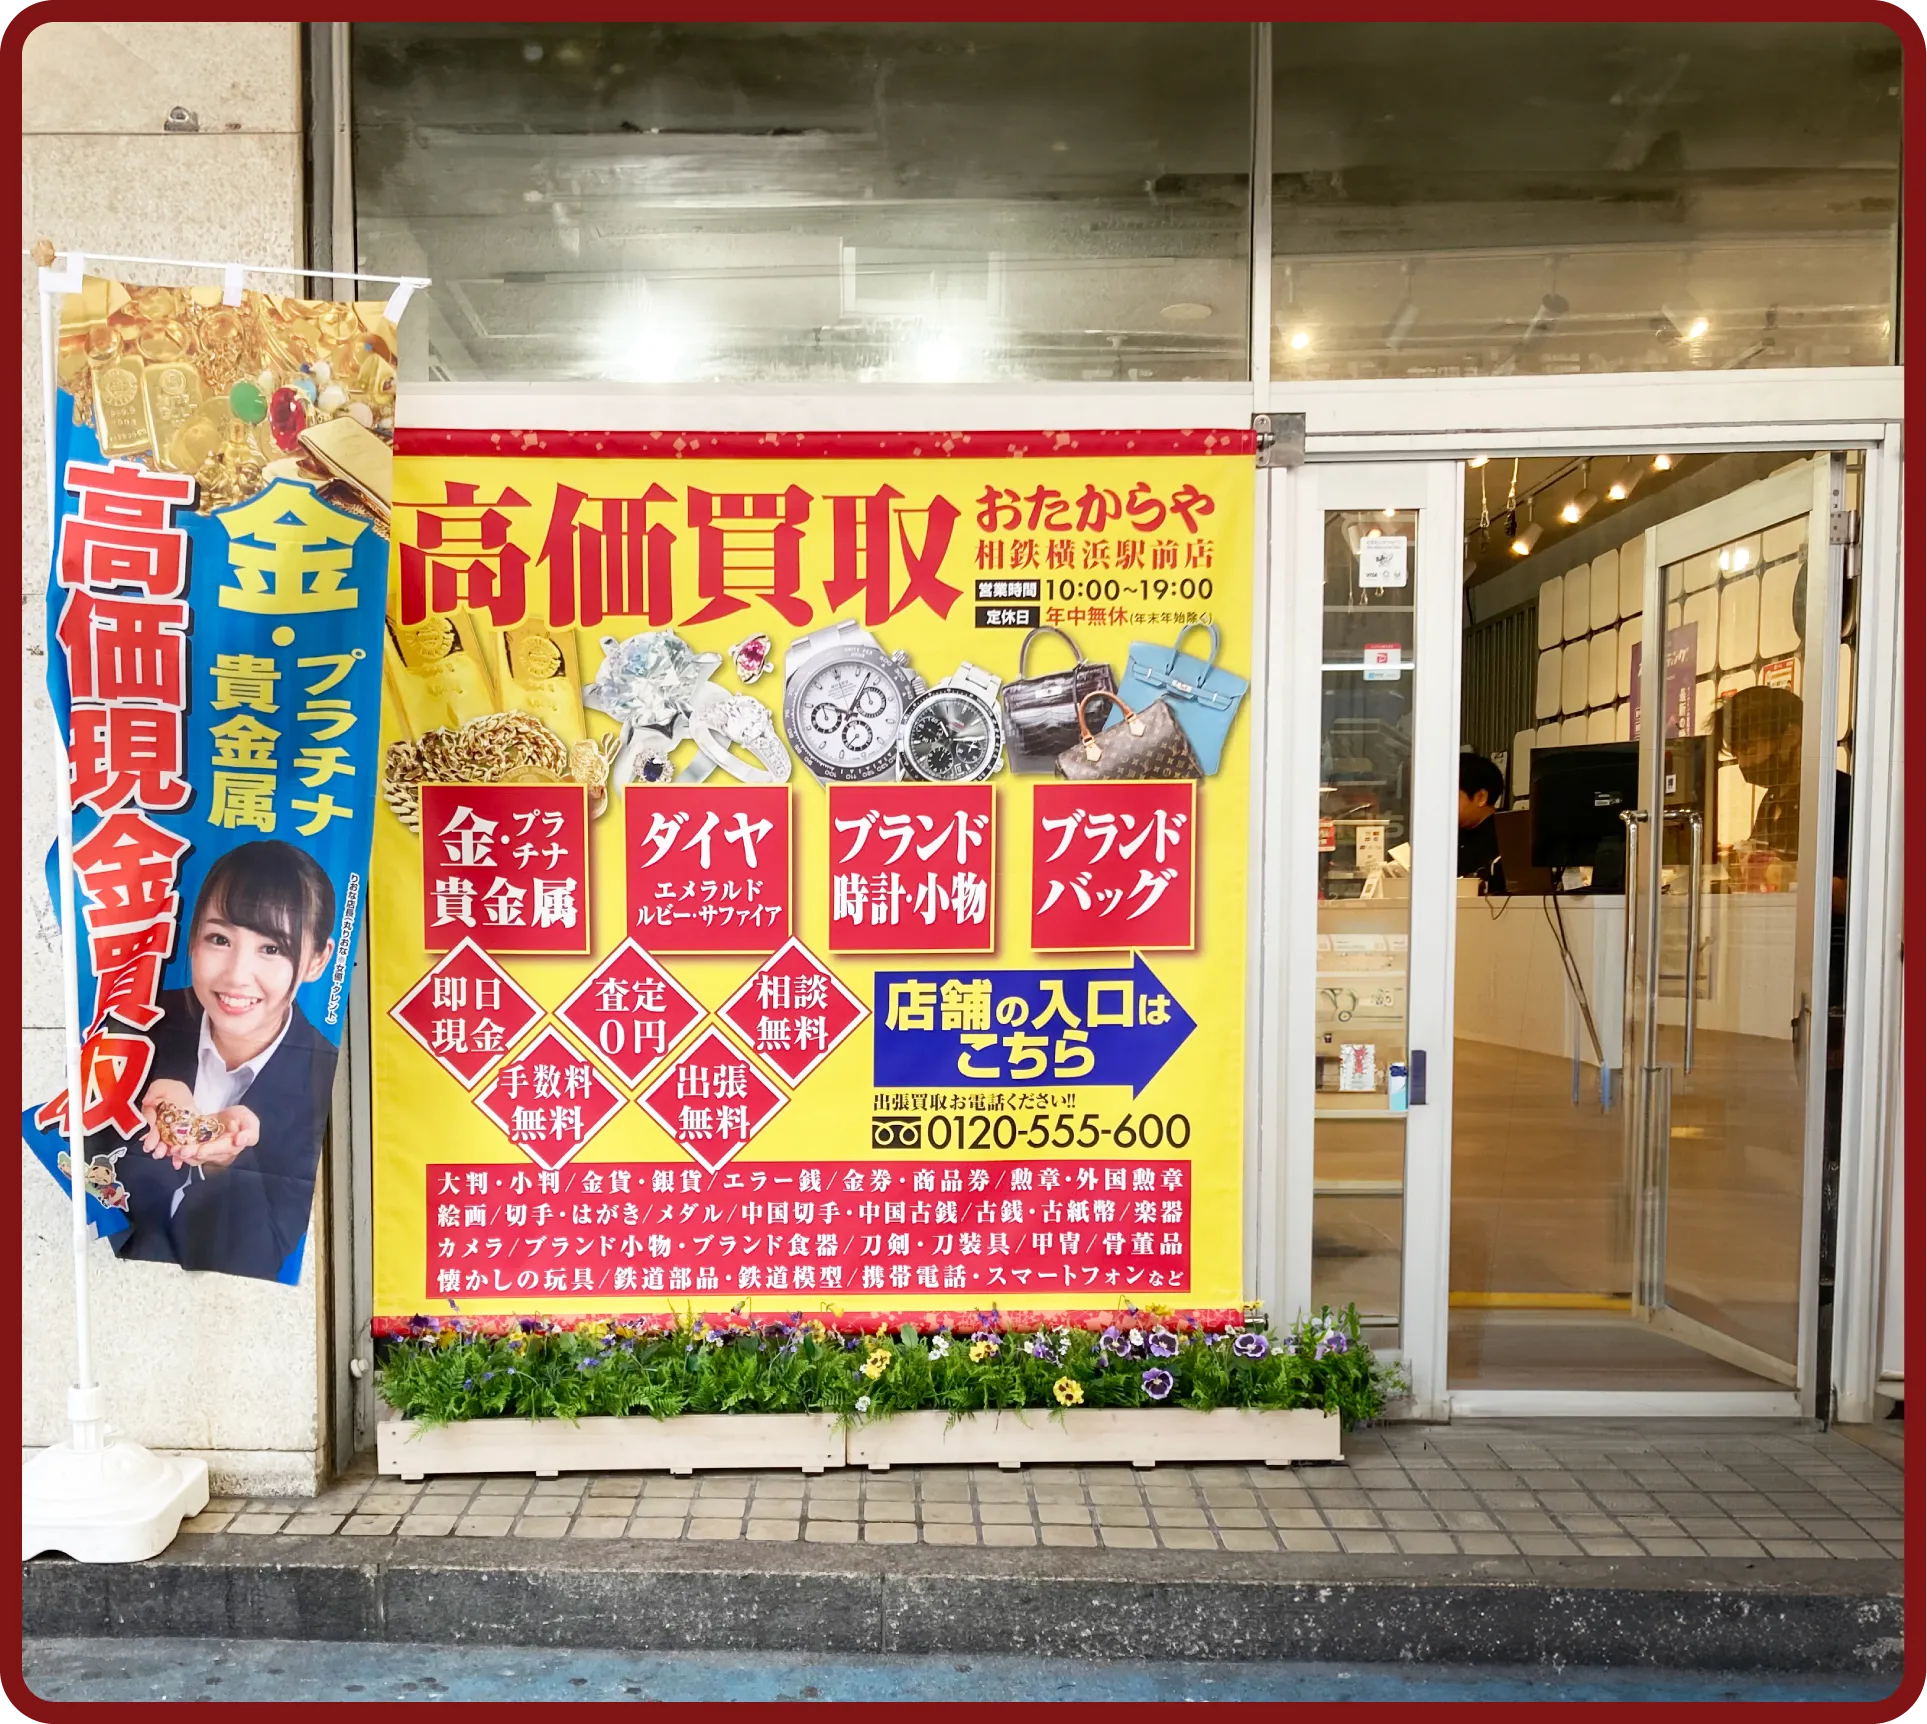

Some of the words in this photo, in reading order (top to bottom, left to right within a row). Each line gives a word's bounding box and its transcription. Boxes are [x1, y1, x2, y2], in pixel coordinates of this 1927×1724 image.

[977, 482, 1214, 533] おたからや
[392, 481, 965, 628] 高価買取
[976, 540, 1211, 569] 相鉄横浜駅前店
[979, 582, 1036, 597] 営業時間
[987, 610, 1029, 624] 定休日
[209, 655, 280, 831] 貴金属
[292, 648, 367, 835] プラチナ
[641, 812, 773, 869] ダイヤ
[835, 810, 989, 865] ブランド
[1042, 809, 1186, 864] ブランド
[431, 877, 577, 928] 貴金属
[655, 879, 763, 902] エメラルド
[833, 872, 989, 926] 時計・小物
[1036, 867, 1179, 922] バッグ
[637, 904, 782, 926] ルビー・サファイア
[434, 976, 502, 1014] 即日
[594, 976, 668, 1012] 査定
[756, 974, 828, 1010] 相談
[885, 979, 1172, 1031] 店舗の入口は
[432, 1018, 505, 1054] 現金
[598, 1019, 667, 1055] 0円
[757, 1019, 828, 1051] 無料
[957, 1032, 1095, 1079] こちら
[500, 1066, 592, 1100] 手数料
[676, 1066, 748, 1100] 出張
[511, 1107, 585, 1141] 無料
[679, 1106, 750, 1140] 無料
[928, 1114, 1190, 1149] 0120-555-600
